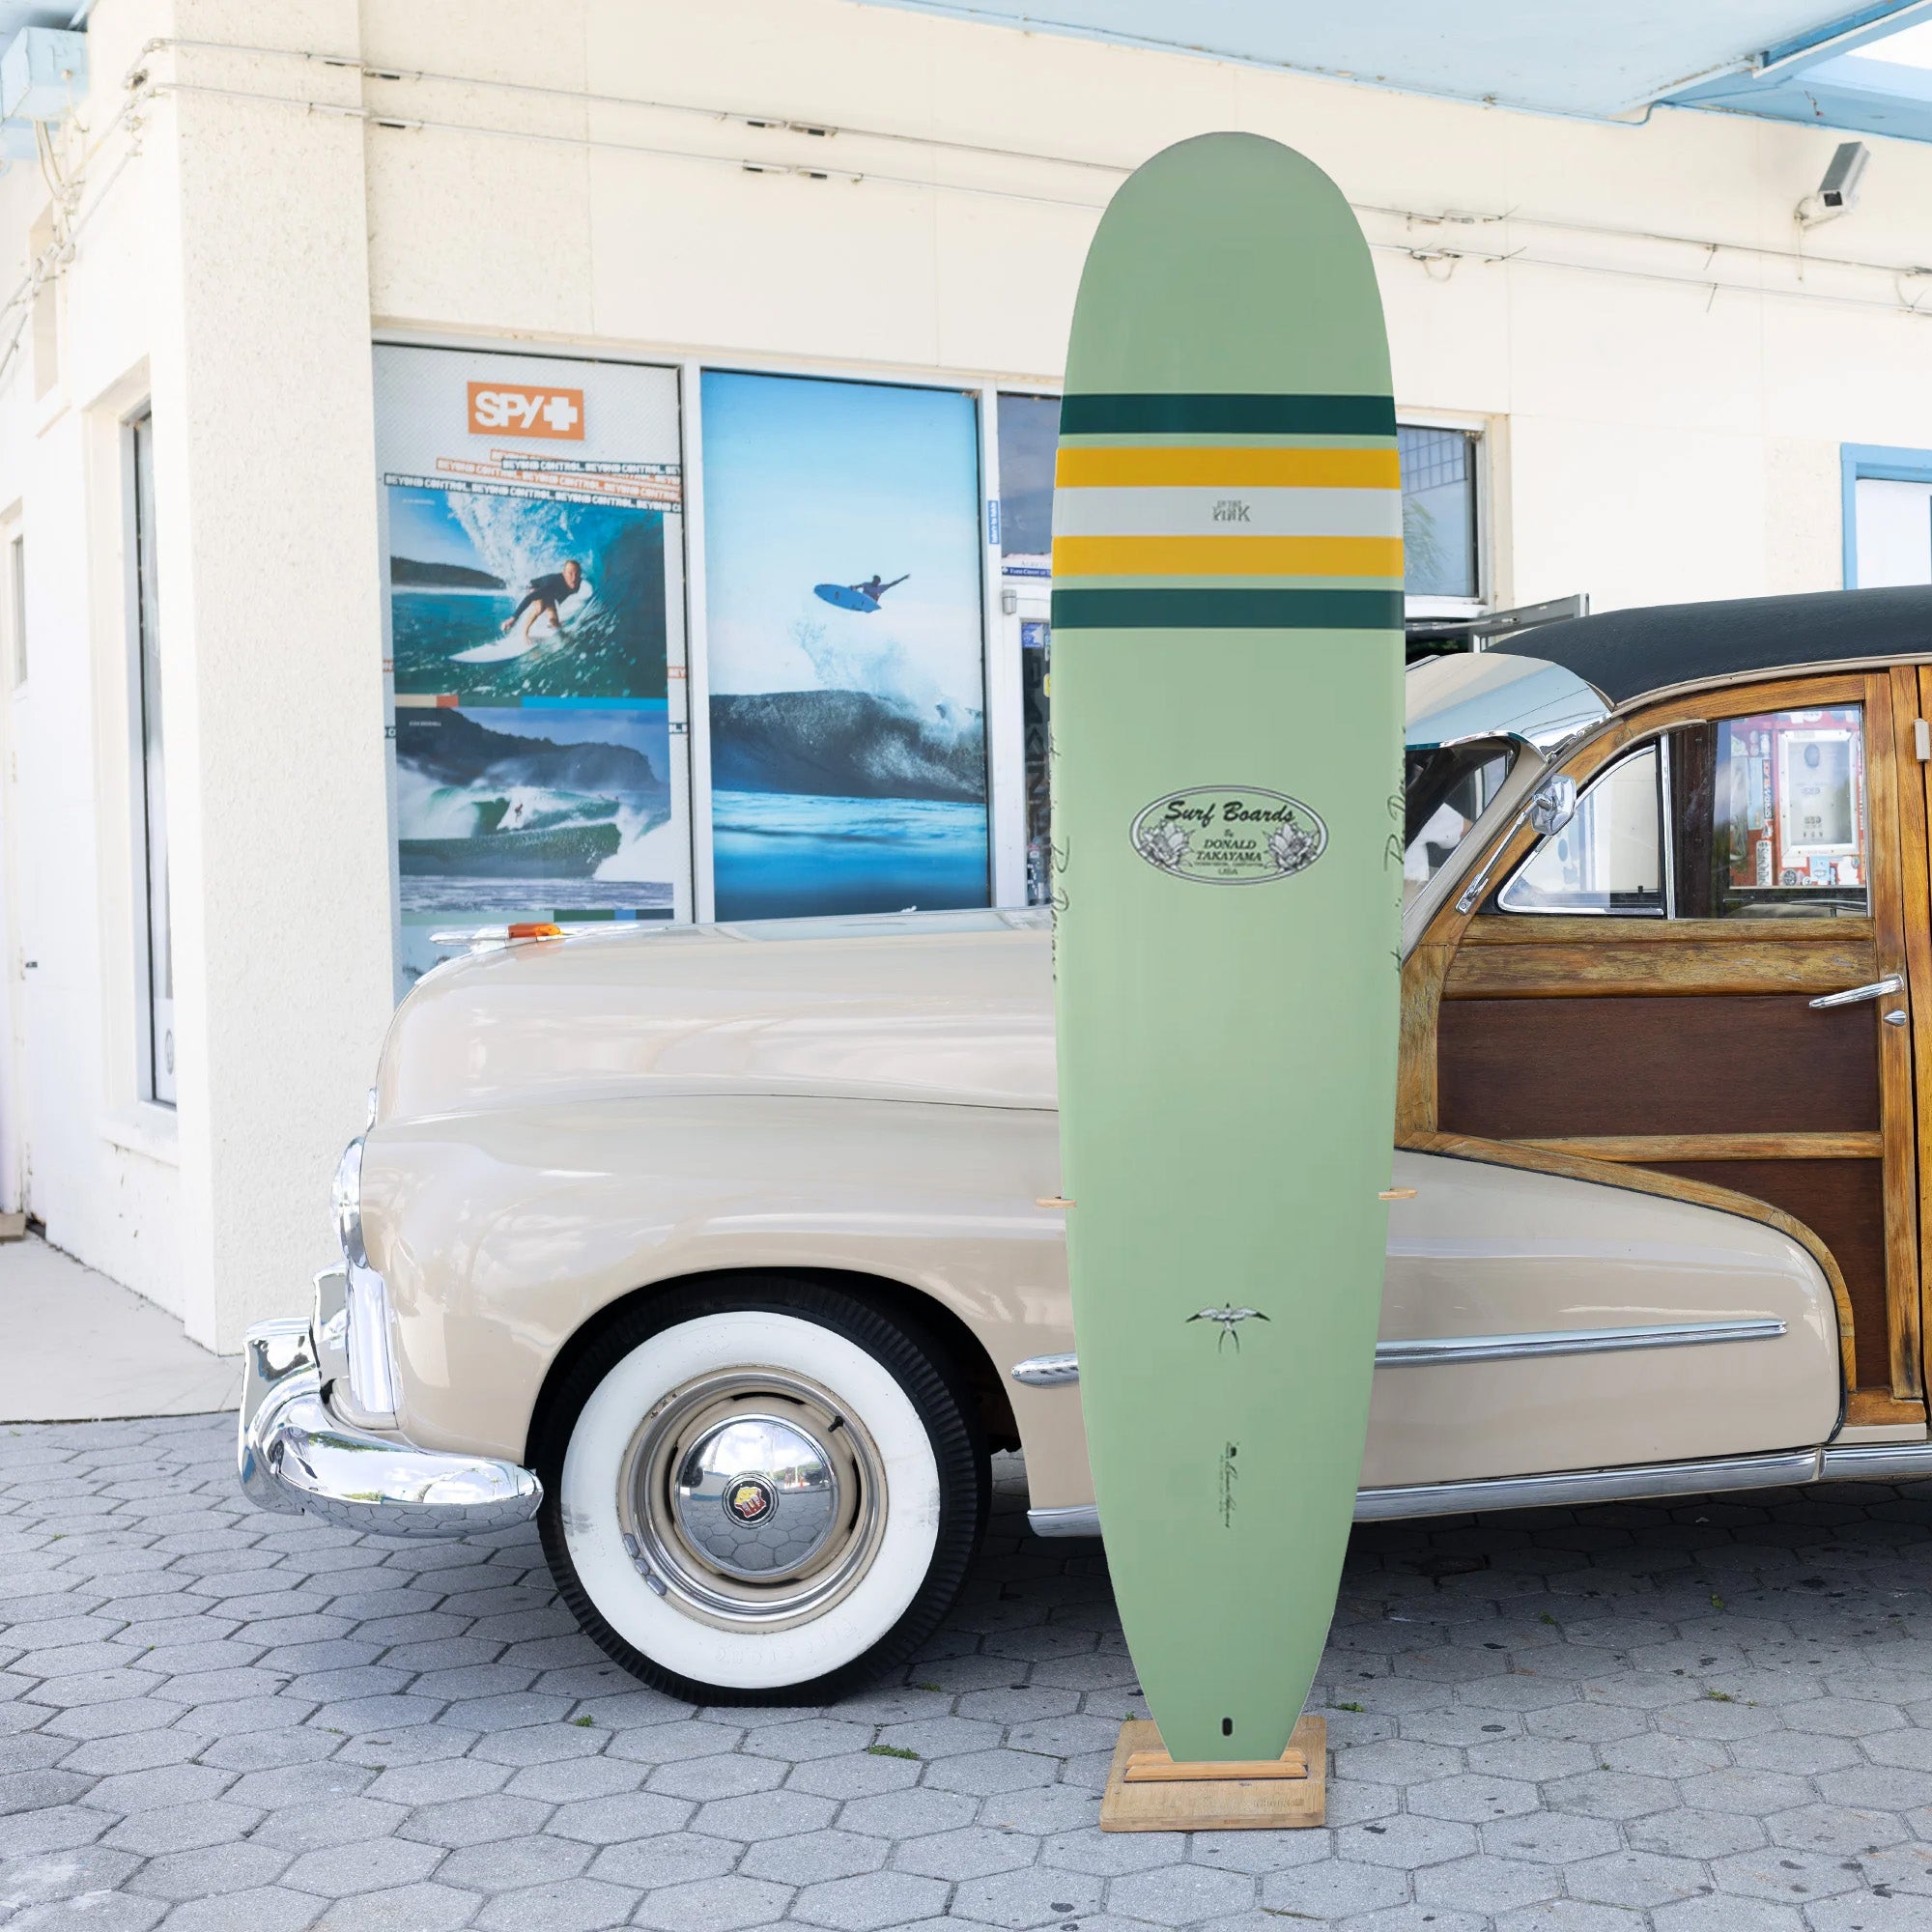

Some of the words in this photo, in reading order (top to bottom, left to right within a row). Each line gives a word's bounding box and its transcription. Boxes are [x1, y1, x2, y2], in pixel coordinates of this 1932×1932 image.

[437, 458, 475, 474] BEYOND
[502, 459, 540, 470] BEYOND
[584, 462, 621, 473] BEYOND
[384, 473, 424, 489] BEYOND
[471, 483, 509, 496] BEYOND
[555, 491, 591, 504] BEYOND
[637, 499, 671, 511] BEYOND
[1164, 800, 1216, 828] Surf
[1222, 801, 1294, 823] Boards
[1204, 838, 1257, 849] DONALD
[1196, 851, 1262, 861] TAKAYAMA
